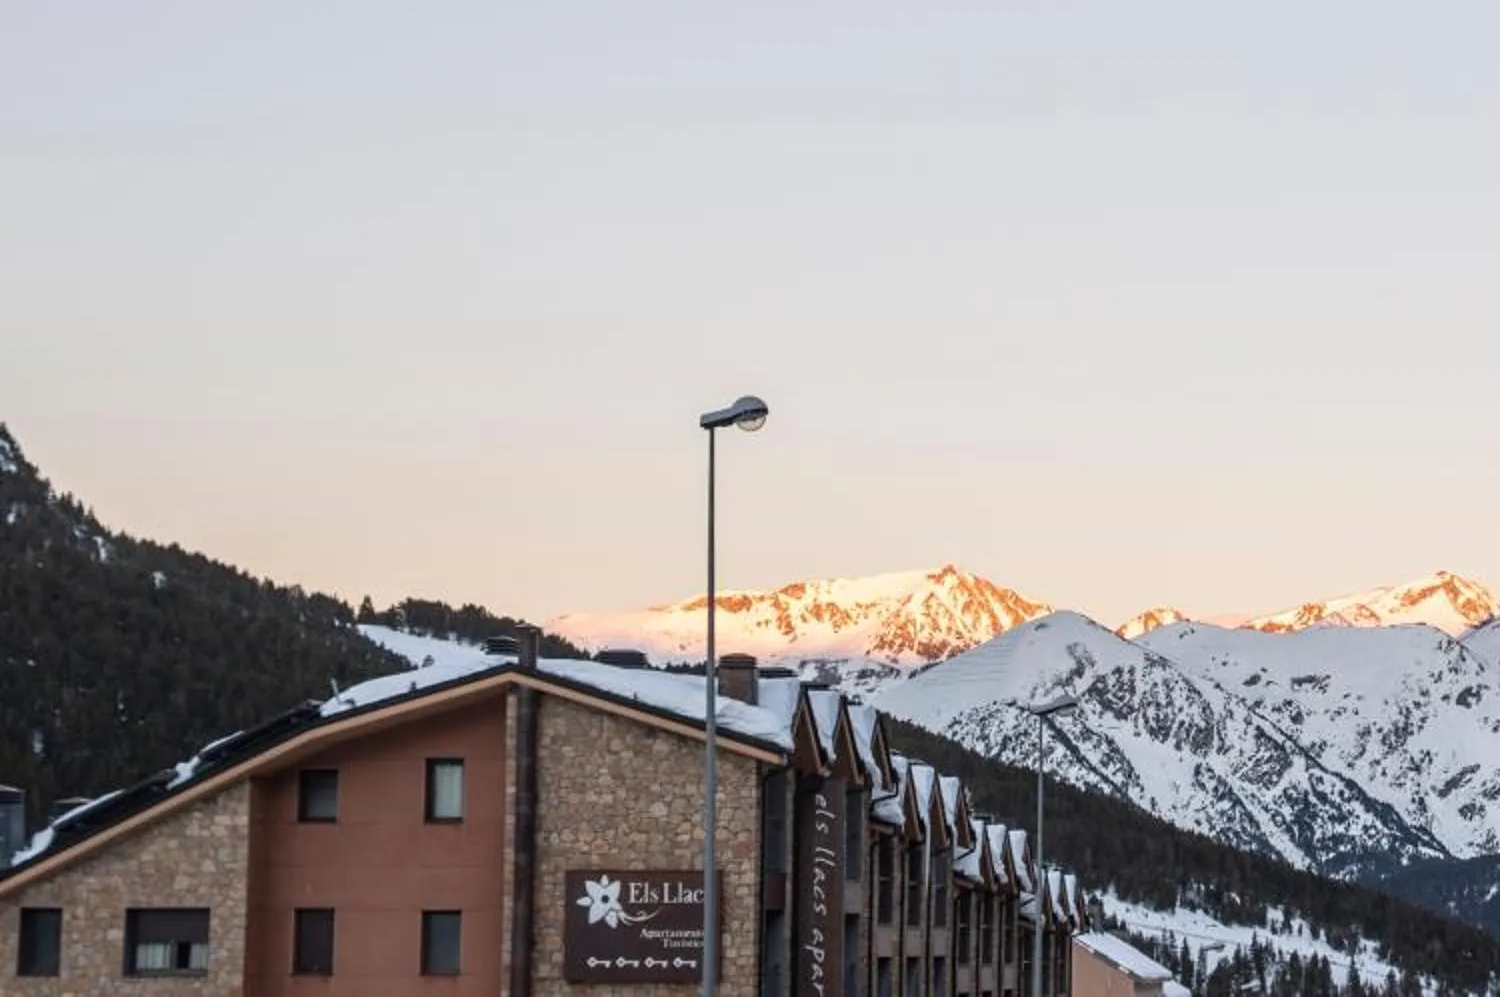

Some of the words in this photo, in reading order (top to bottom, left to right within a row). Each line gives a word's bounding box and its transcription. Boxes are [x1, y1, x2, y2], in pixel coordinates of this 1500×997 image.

[815, 794, 835, 834] els
[628, 881, 660, 905] Els
[662, 881, 705, 905] Llac
[813, 846, 836, 917] llacs
